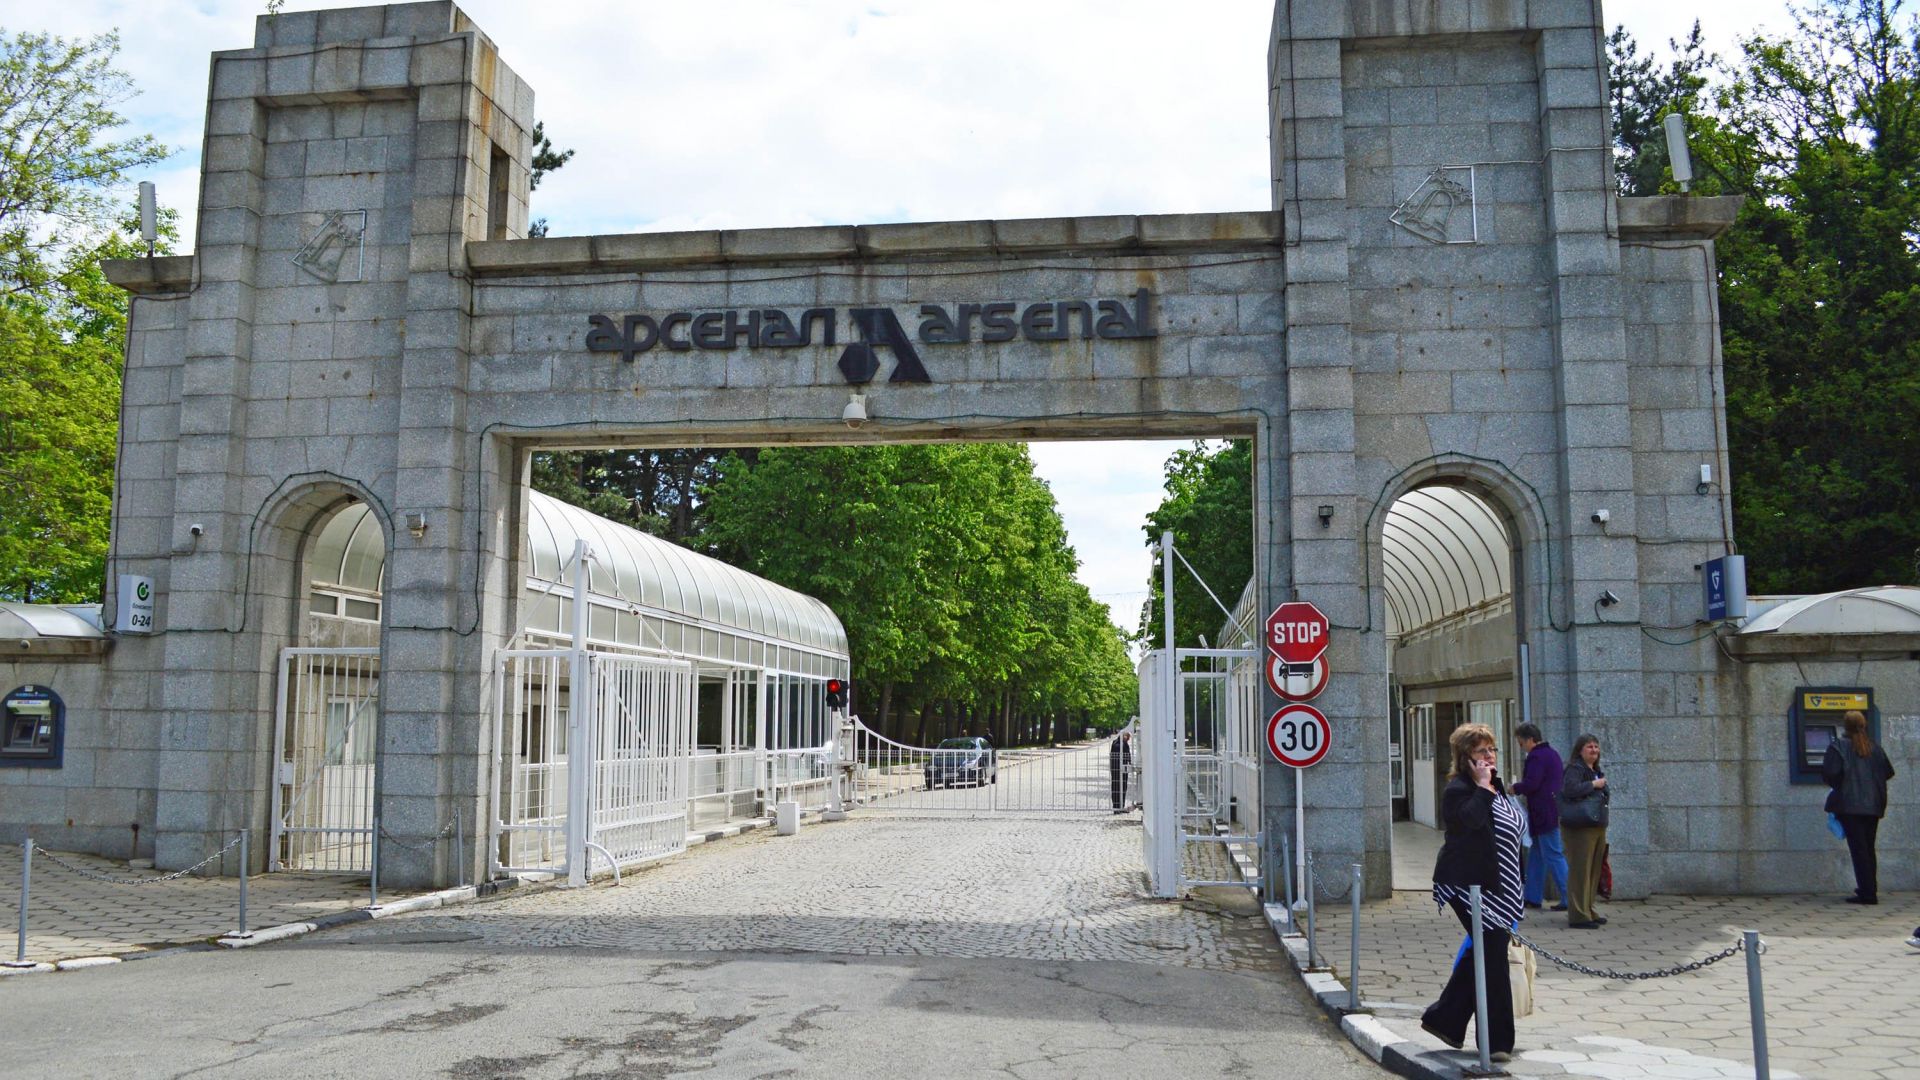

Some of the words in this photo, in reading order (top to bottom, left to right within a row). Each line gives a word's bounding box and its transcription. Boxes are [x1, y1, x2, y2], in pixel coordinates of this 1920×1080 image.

[918, 287, 1158, 343] arsenal
[132, 614, 151, 627] 0-24
[1273, 621, 1321, 644] STOP
[1281, 721, 1318, 751] 30
